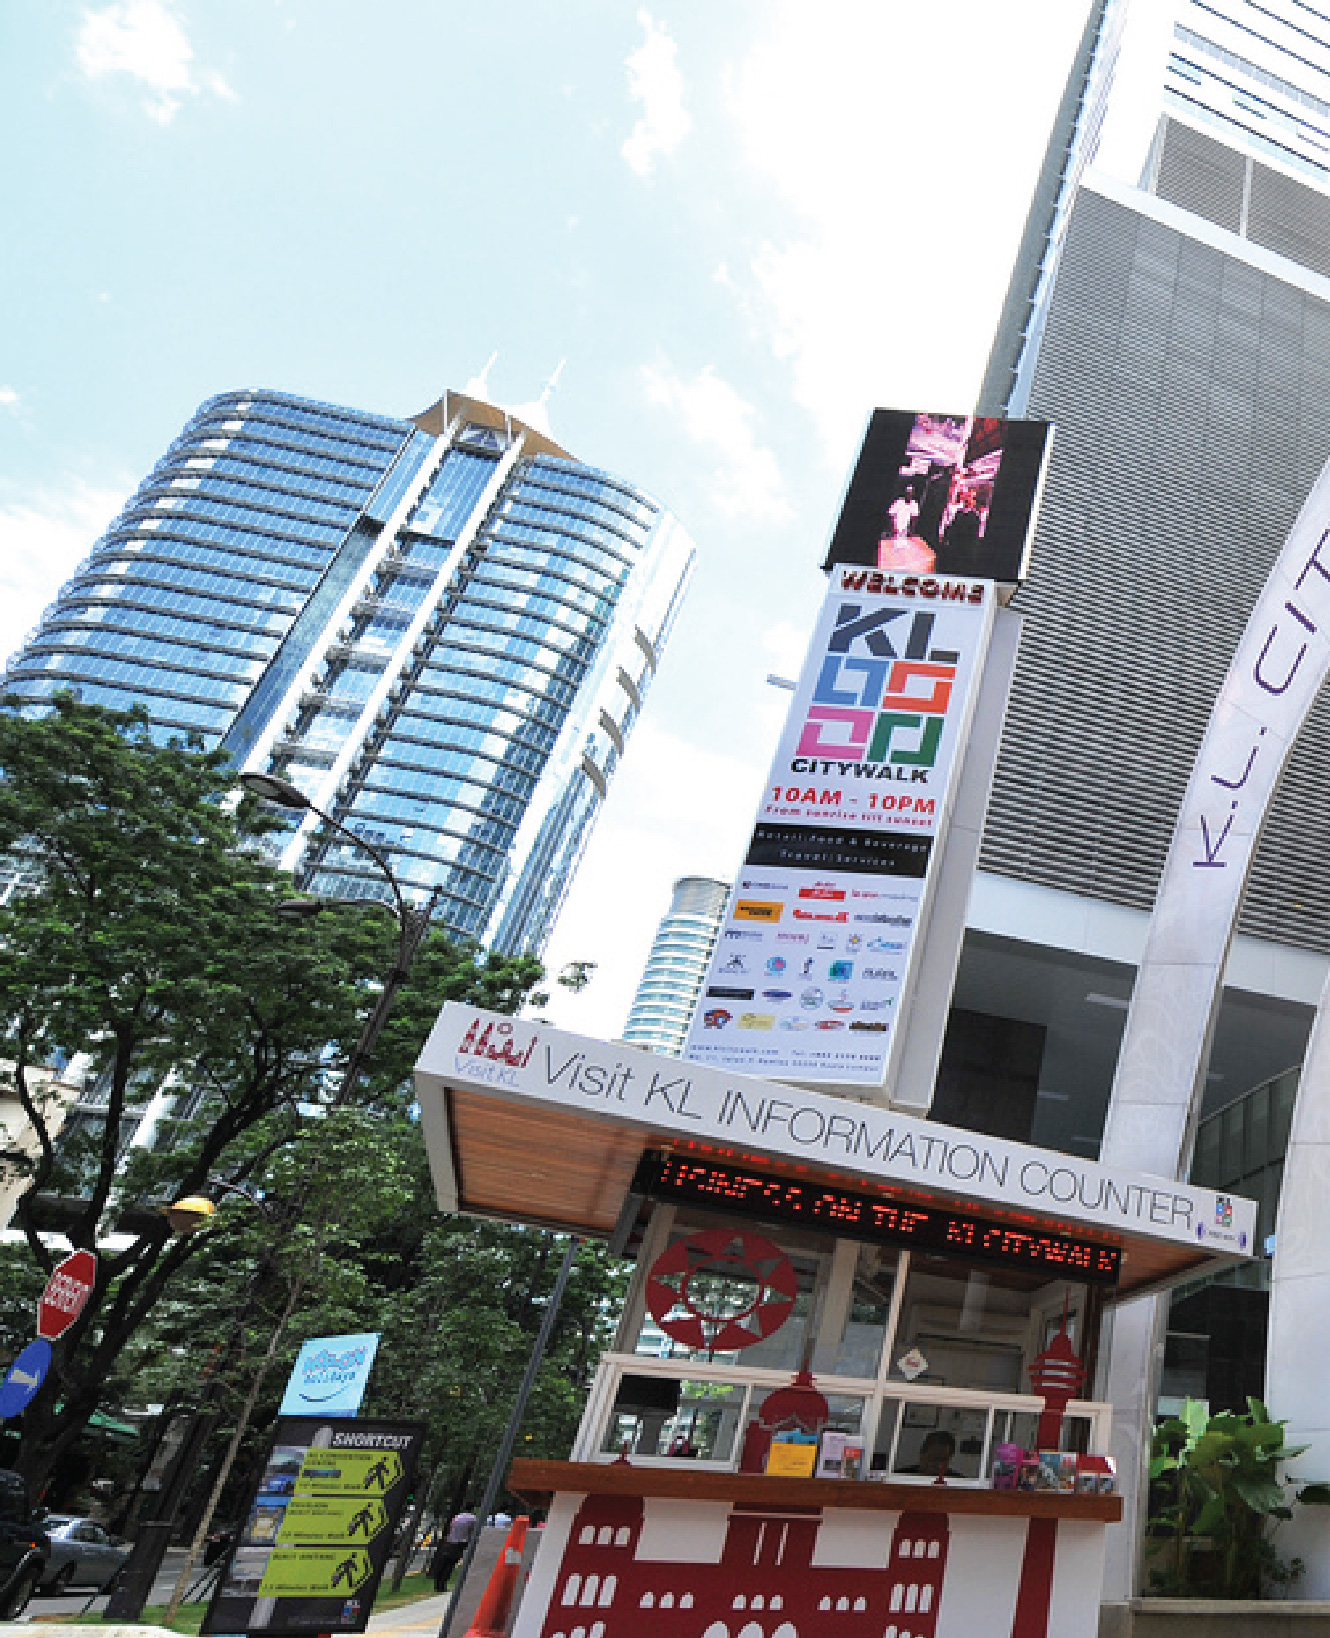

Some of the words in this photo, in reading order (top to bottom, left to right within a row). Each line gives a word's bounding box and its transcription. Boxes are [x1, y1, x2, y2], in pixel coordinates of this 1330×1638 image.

[827, 603, 960, 663] KL
[791, 758, 929, 784] CITYWALK
[771, 786, 842, 806] 10AM
[869, 793, 936, 815] 10PM
[455, 1055, 496, 1082] Visit
[497, 1067, 519, 1087] KL
[543, 1044, 636, 1101] Visit
[644, 1073, 702, 1120] KL
[717, 1089, 1009, 1188] INFORMATION
[1020, 1160, 1195, 1232] COUNTER
[332, 1432, 413, 1448] SHORTCUT
